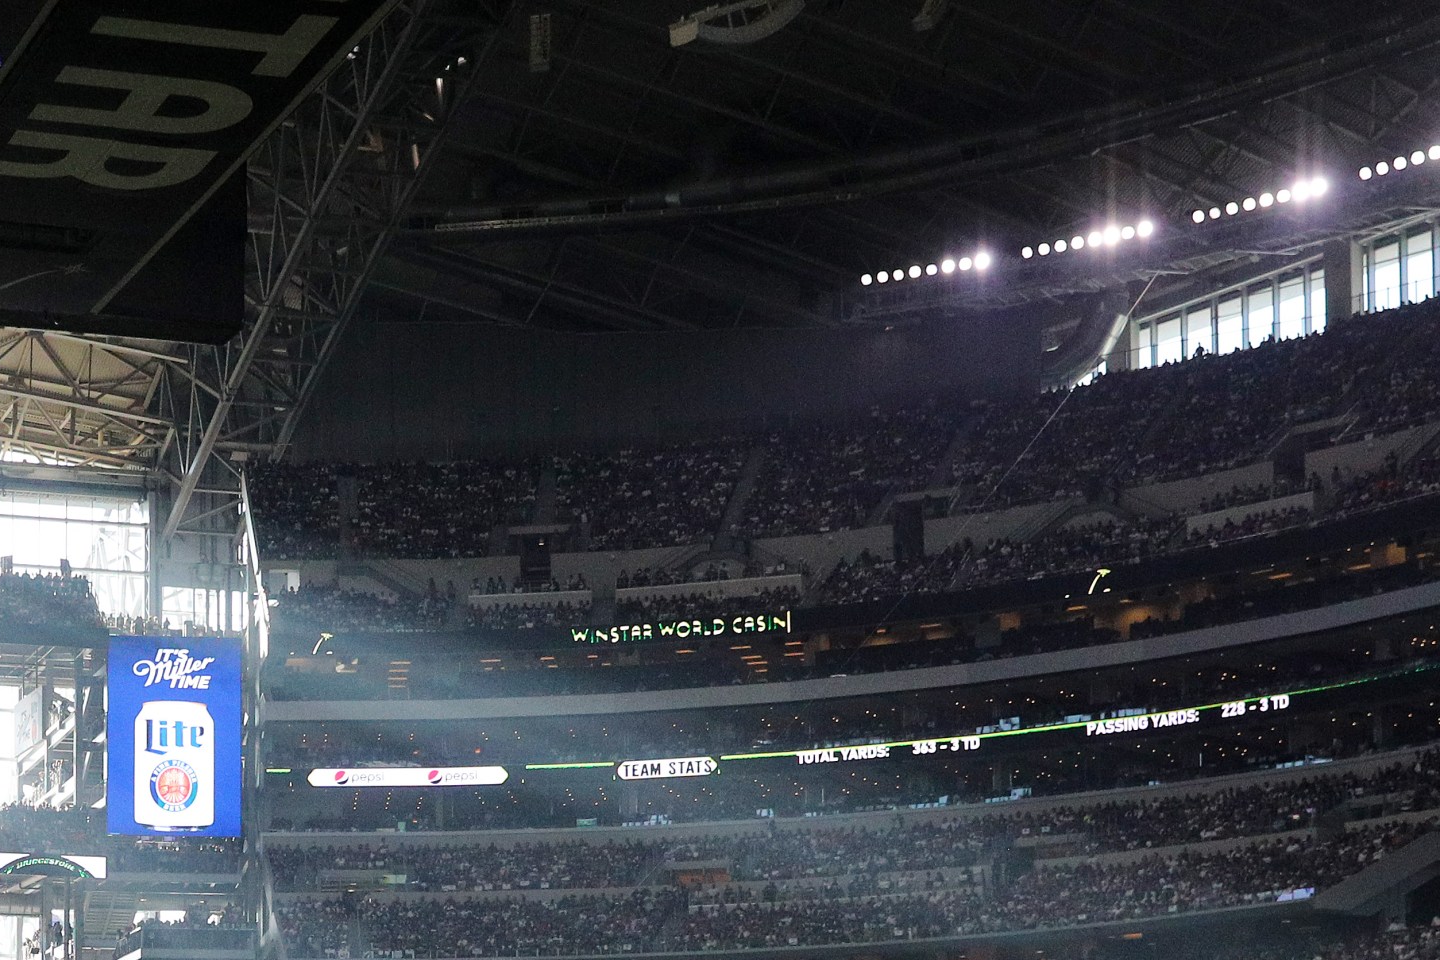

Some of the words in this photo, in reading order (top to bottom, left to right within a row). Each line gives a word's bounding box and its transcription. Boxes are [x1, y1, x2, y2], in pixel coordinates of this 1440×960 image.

[571, 623, 652, 643] WINSTAR
[658, 618, 725, 639] WORLD
[155, 649, 190, 663] IT'S
[132, 657, 215, 687] Miller
[170, 675, 212, 690] TIME
[1086, 716, 1148, 736] PASSING
[1151, 709, 1200, 728] YARDS:
[1221, 701, 1246, 718] 228
[1260, 698, 1268, 712] 3
[1271, 695, 1290, 711] TD
[144, 719, 205, 755] Lite
[796, 750, 839, 765] TOTAL
[841, 746, 890, 761] YARDS:
[962, 736, 981, 751] TD
[351, 770, 385, 784] pepsi
[445, 769, 478, 783] pepsi
[623, 763, 661, 777] TEAM
[668, 760, 713, 775] STATS
